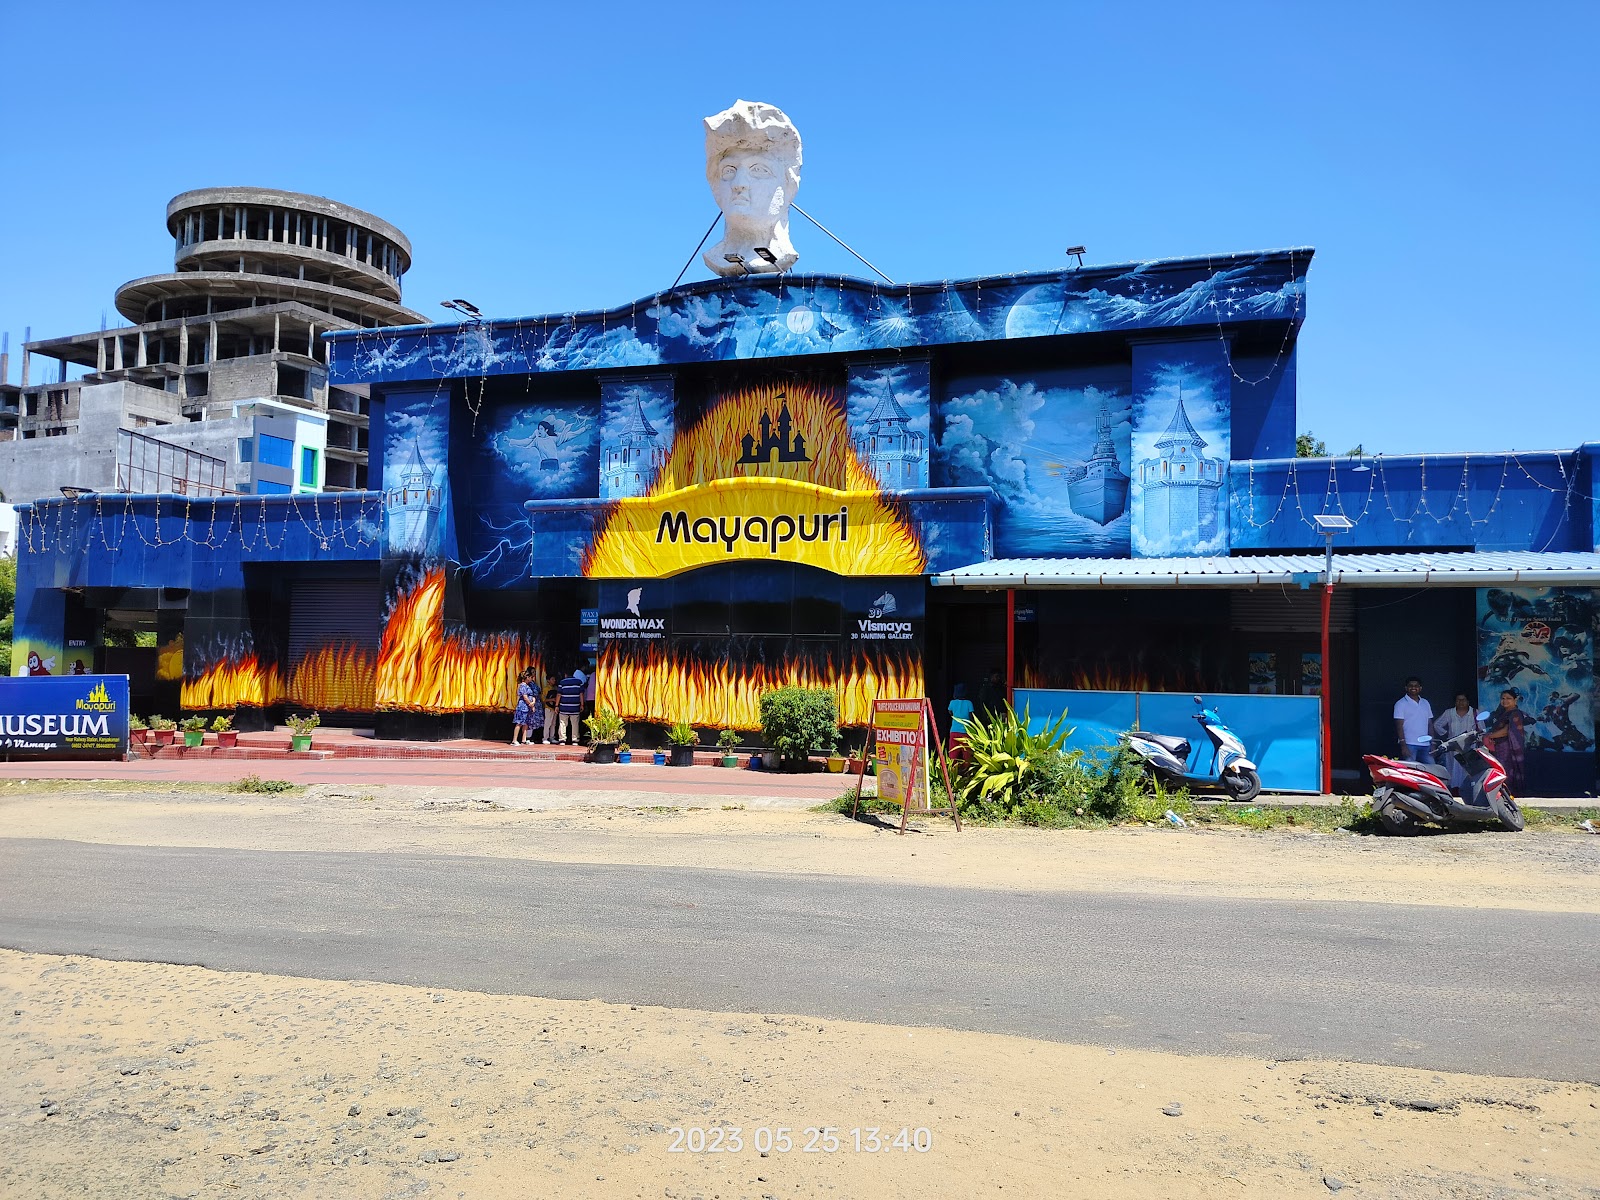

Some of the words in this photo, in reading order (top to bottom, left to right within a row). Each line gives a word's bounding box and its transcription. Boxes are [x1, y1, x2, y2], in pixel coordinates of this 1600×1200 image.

[656, 507, 848, 553] Mayapuri
[868, 608, 882, 618] 3D
[601, 618, 637, 630] WONDER
[638, 618, 665, 630] WAX
[858, 620, 912, 633] Vismaya
[76, 699, 116, 712] Mayapuri
[0, 715, 110, 736] USEUM
[13, 739, 57, 750] Vismaya
